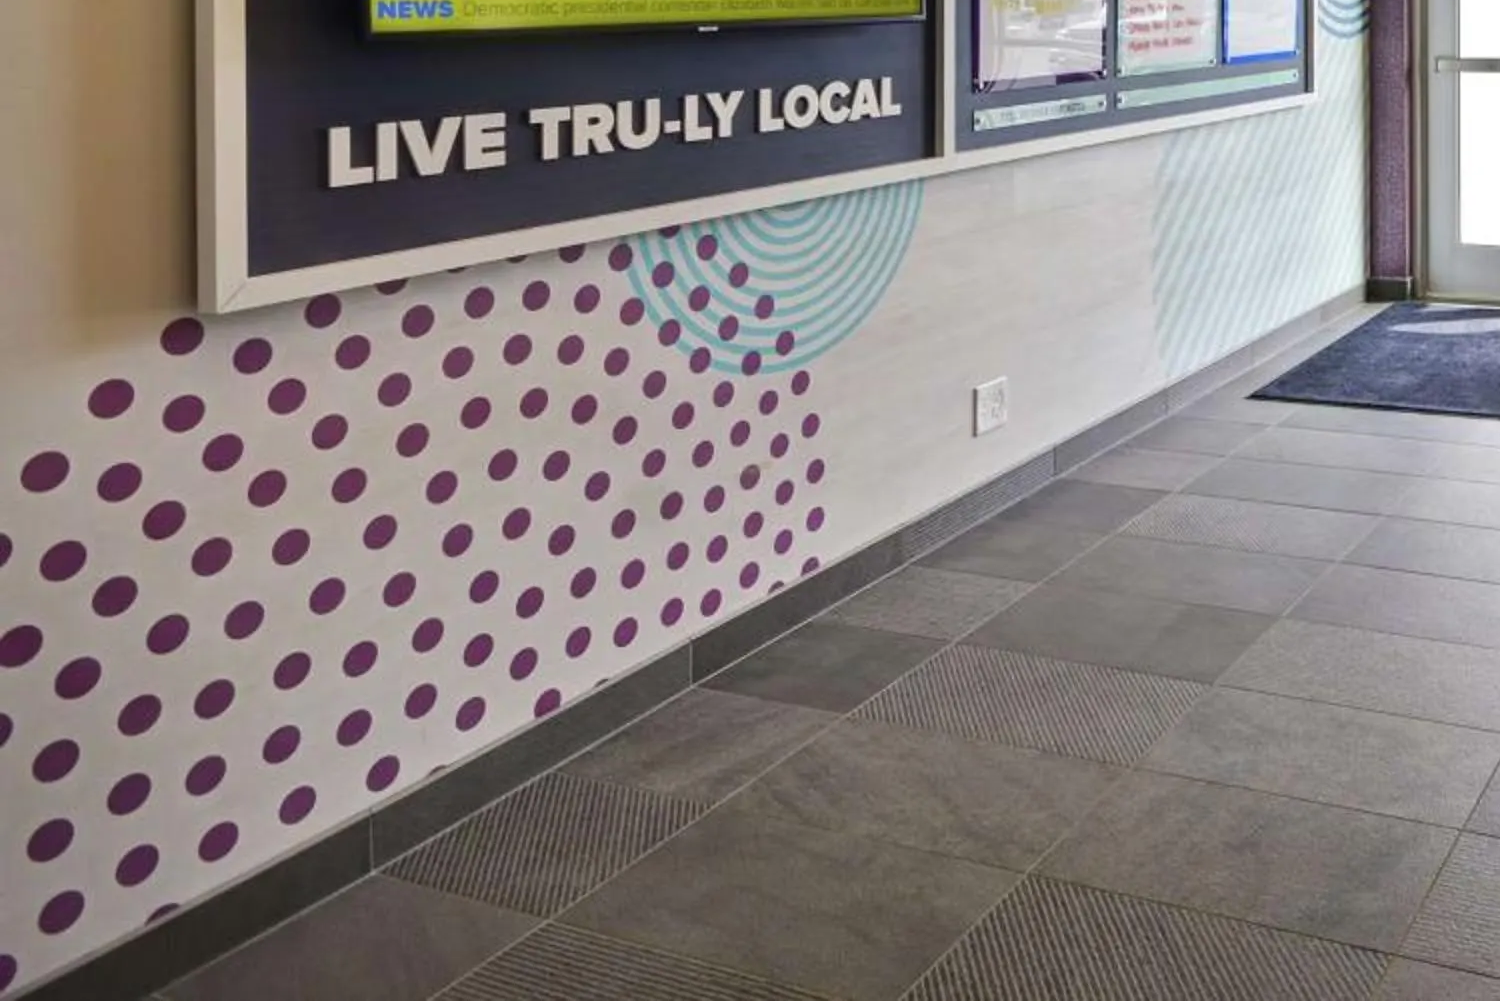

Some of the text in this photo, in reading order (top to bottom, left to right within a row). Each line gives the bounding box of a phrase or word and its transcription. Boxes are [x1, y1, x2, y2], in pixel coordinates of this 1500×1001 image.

[377, 0, 455, 20] NEWS
[462, 0, 559, 18] Democratic
[328, 77, 901, 188] LIVE TRU-LY LOCAL
